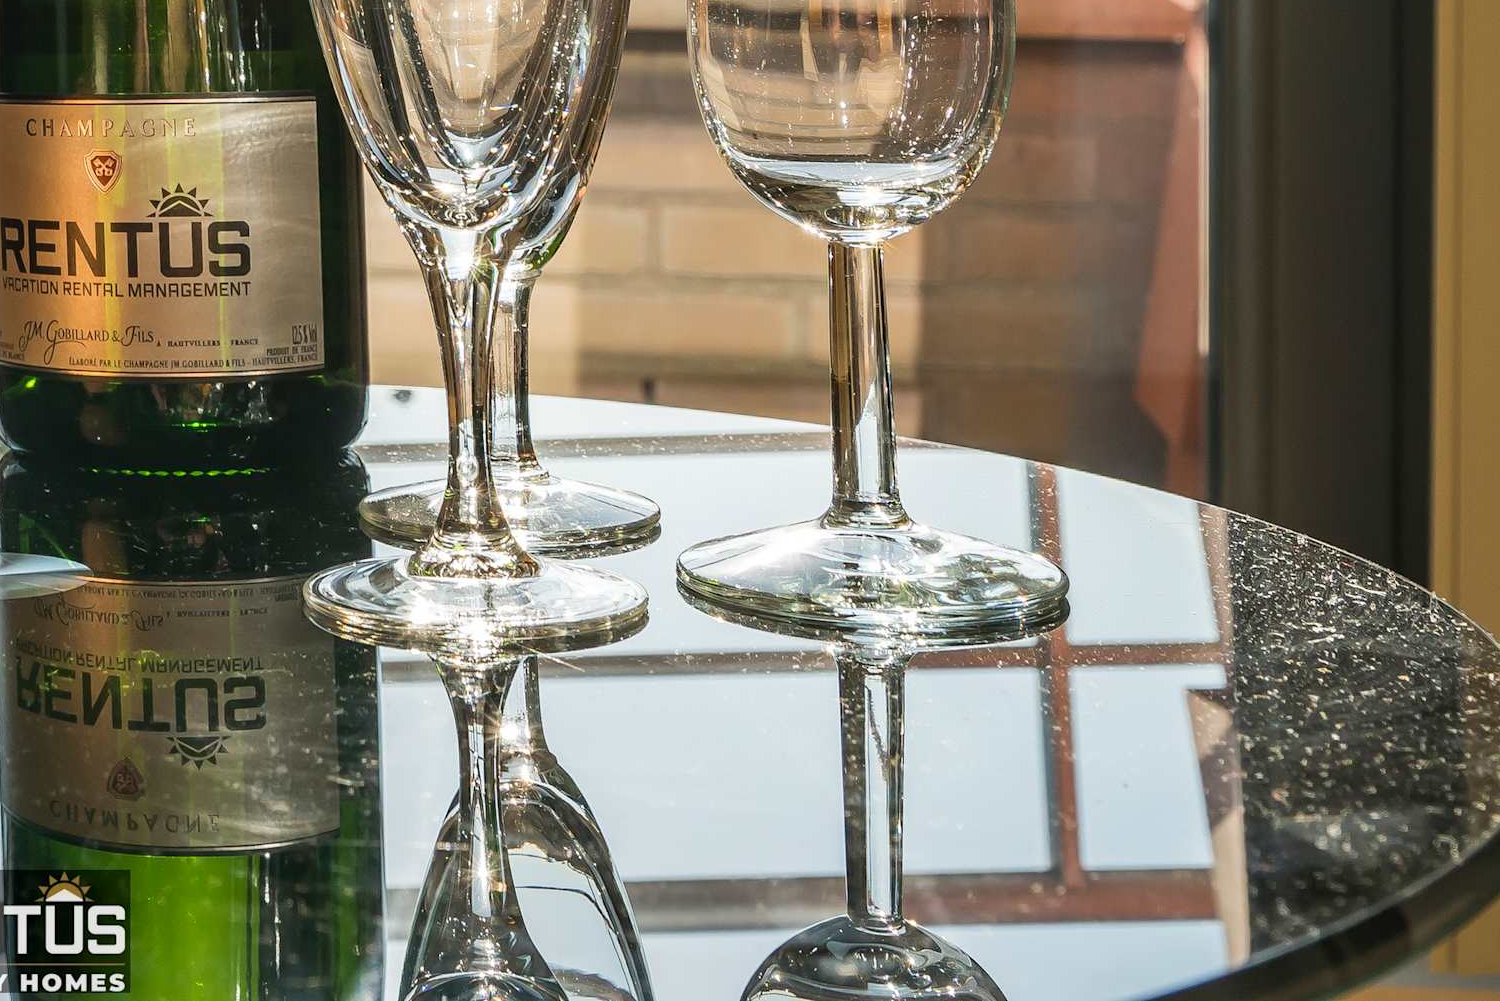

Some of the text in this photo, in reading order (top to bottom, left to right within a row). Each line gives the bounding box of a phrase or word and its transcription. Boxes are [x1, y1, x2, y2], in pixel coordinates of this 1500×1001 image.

[25, 118, 197, 138] CHAMPAGNE
[0, 216, 251, 279] RENTUS
[2, 276, 251, 298] VACATION RENTAL MANAGEMENT
